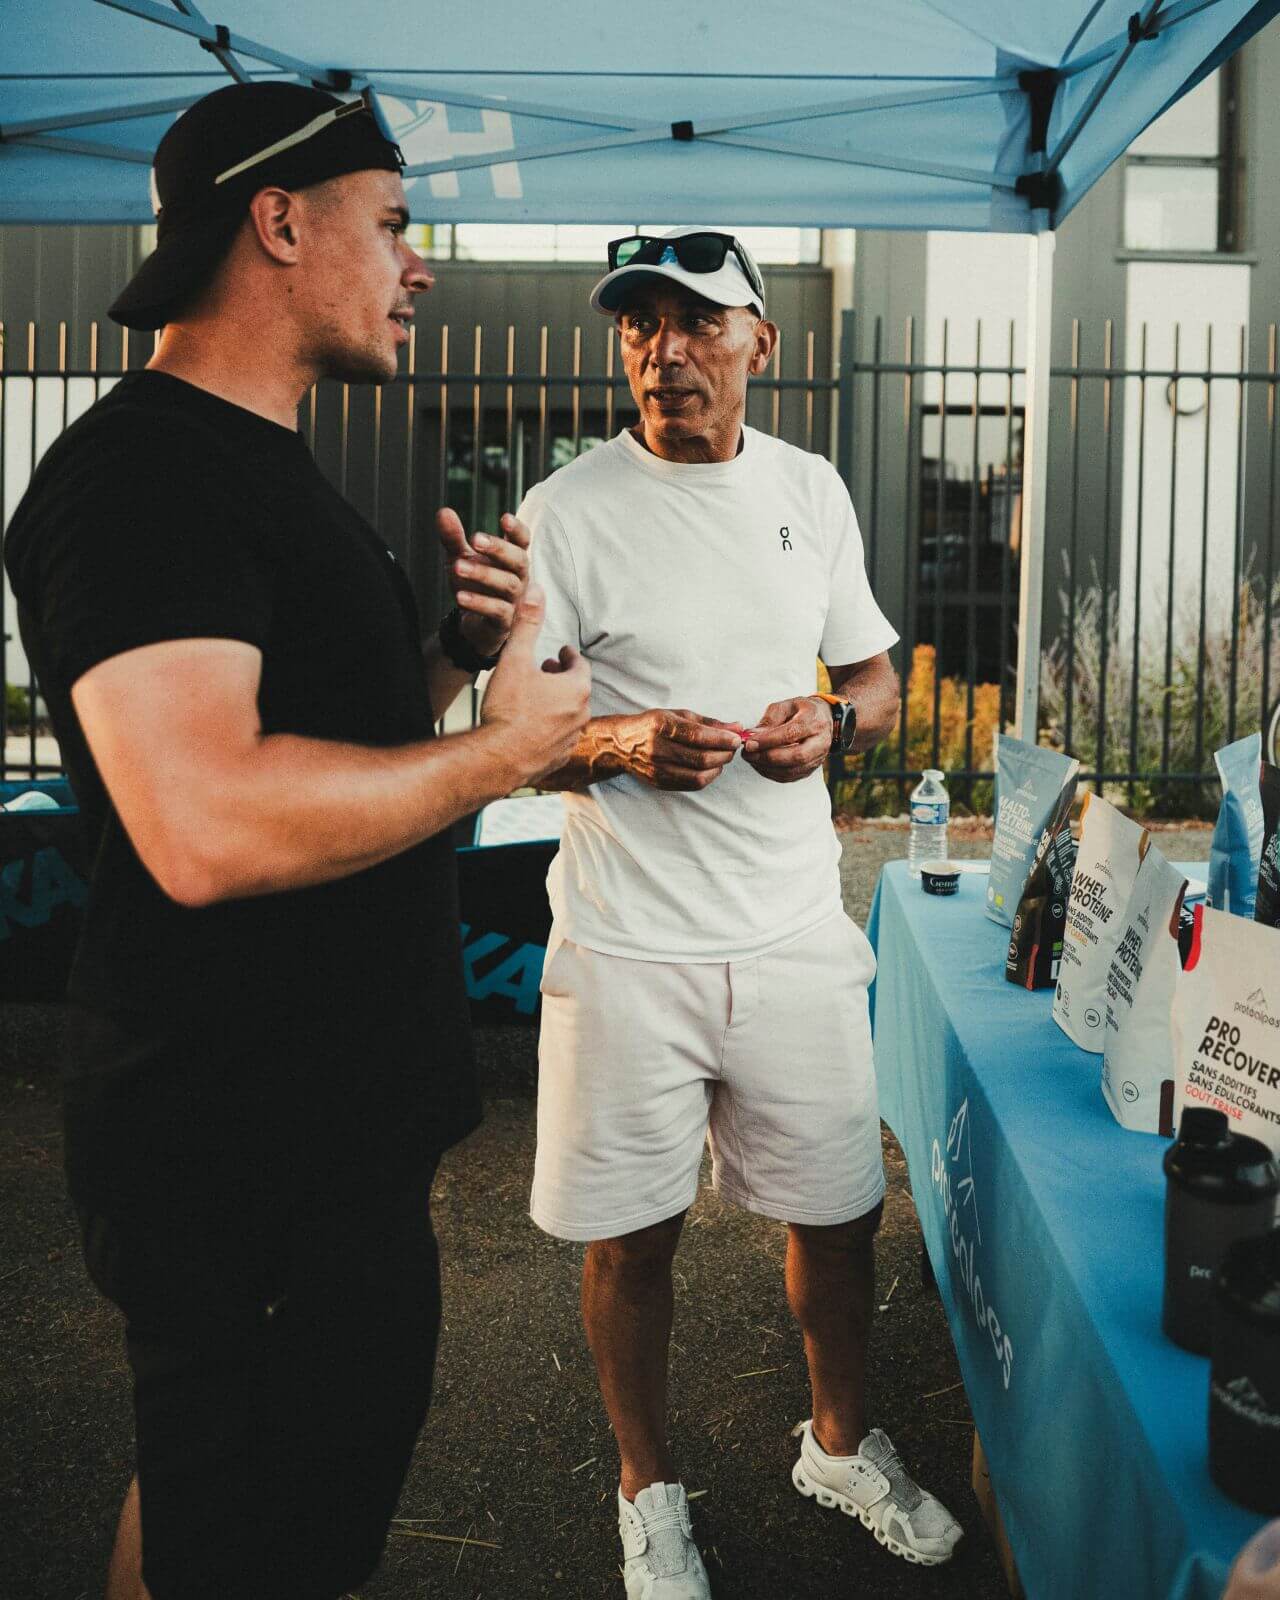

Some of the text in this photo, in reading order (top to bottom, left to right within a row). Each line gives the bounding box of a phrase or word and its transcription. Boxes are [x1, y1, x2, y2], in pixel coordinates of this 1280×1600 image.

[1205, 1016, 1241, 1046] PRO
[1198, 1035, 1280, 1089] RECOVER
[1188, 1072, 1214, 1091] SANS
[1191, 1060, 1257, 1100] SANS ADDITIFS
